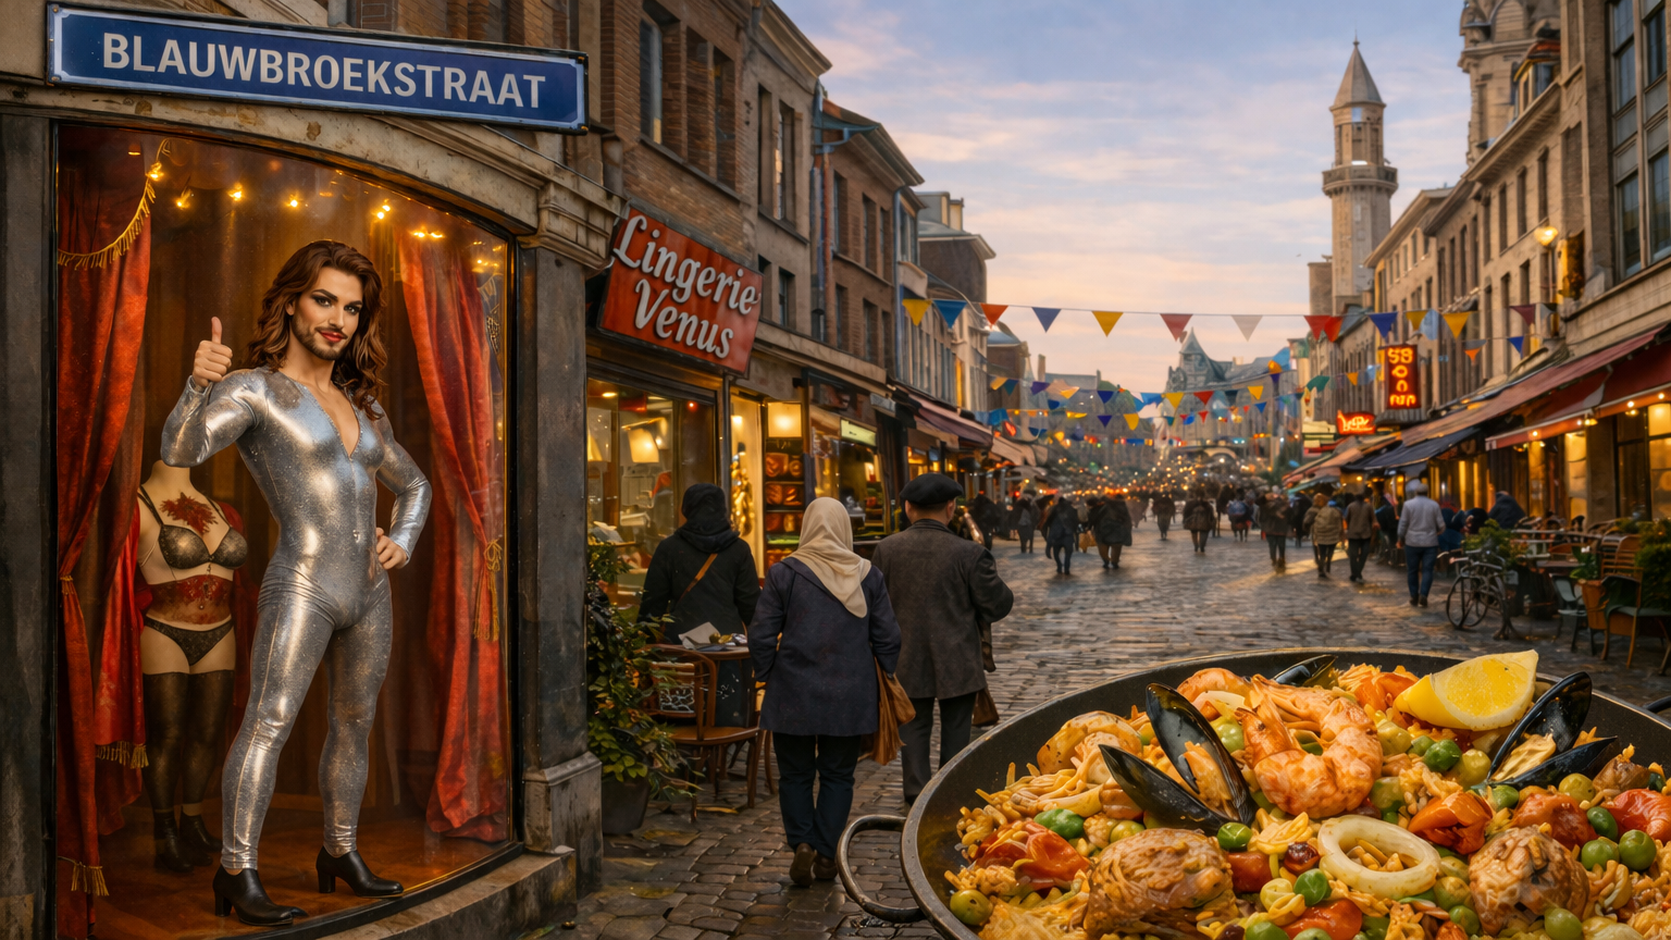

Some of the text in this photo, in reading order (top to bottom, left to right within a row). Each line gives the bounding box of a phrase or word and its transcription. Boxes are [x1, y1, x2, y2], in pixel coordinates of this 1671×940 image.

[103, 32, 546, 108] BLAUWBROEKSTRAAT
[613, 214, 761, 316] Lingerie
[634, 278, 734, 359] Venus
